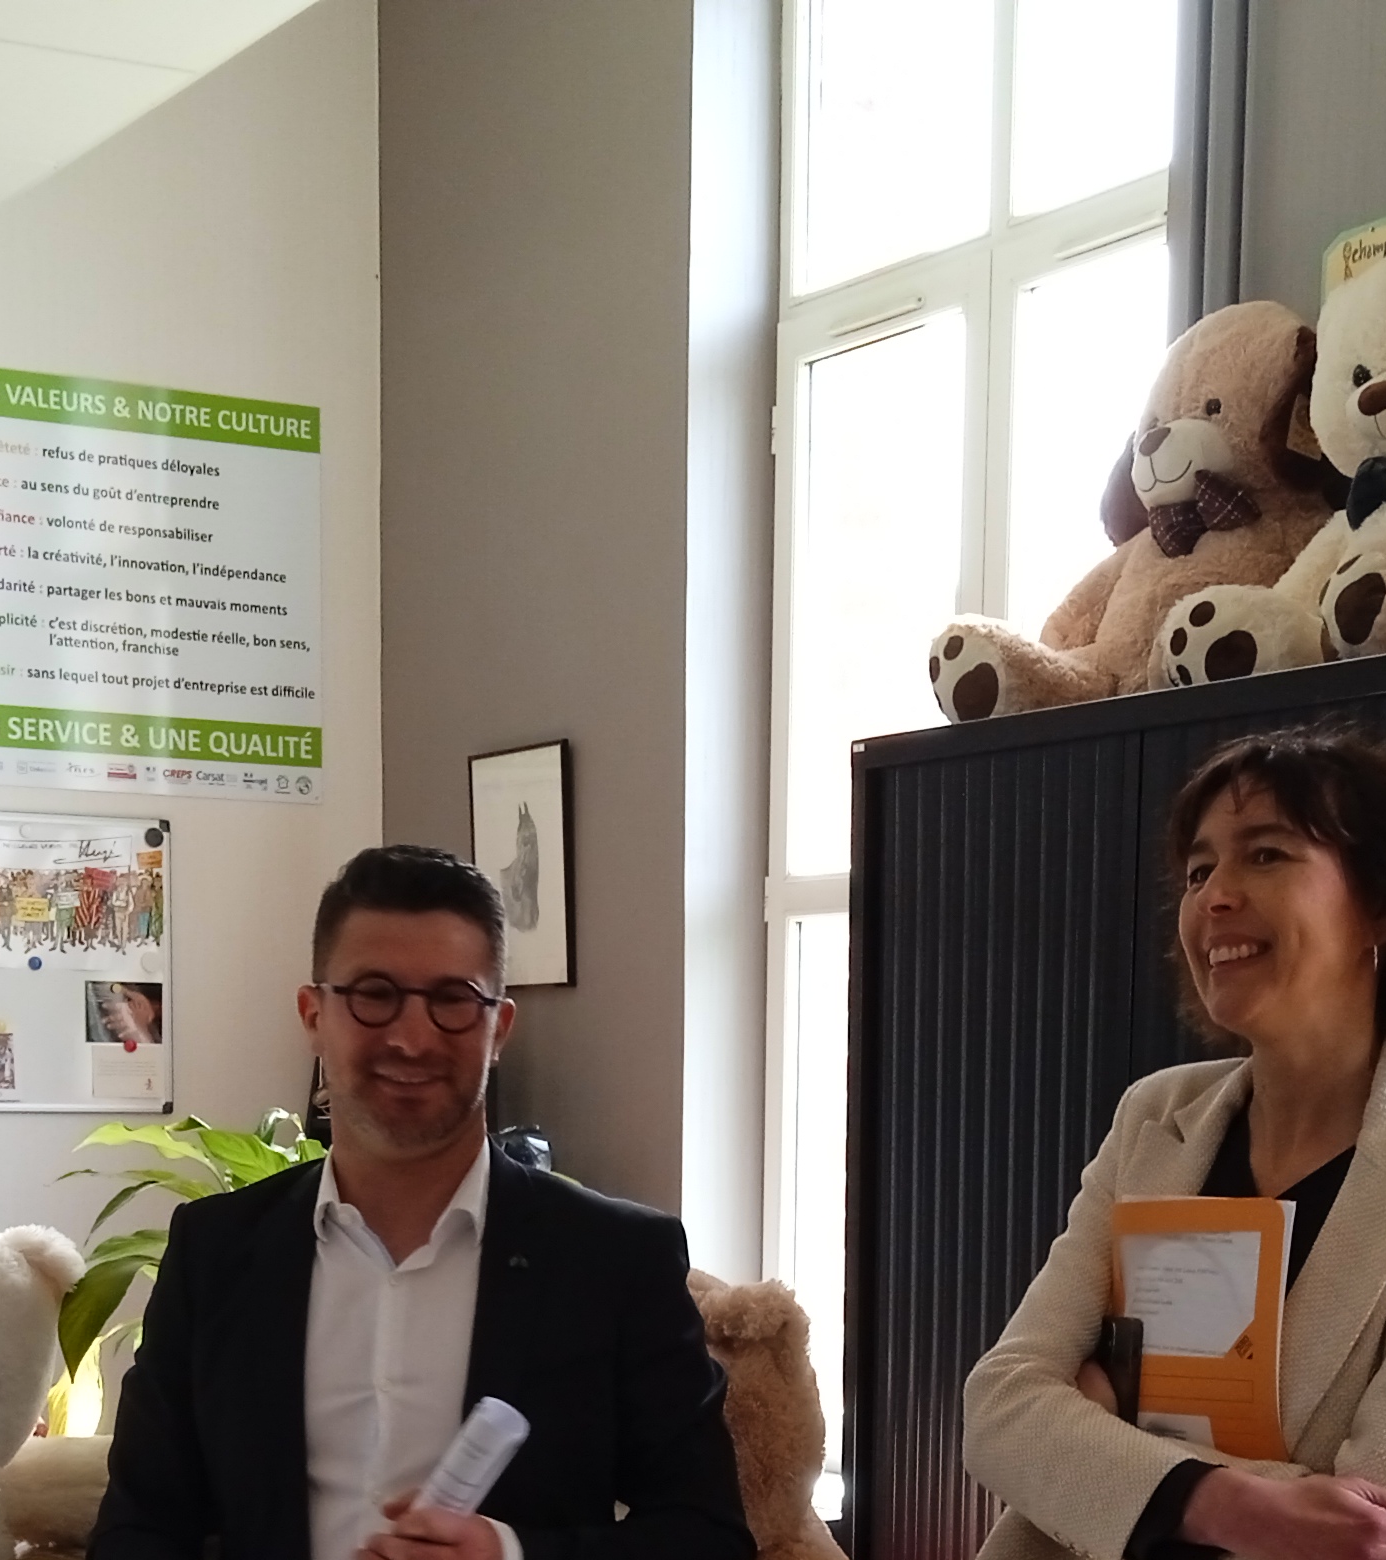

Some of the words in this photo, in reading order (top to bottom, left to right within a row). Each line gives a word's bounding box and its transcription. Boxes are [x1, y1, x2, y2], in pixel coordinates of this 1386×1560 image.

[6, 384, 106, 416] VALEURS
[113, 397, 130, 418] &
[137, 400, 210, 427] NOTRE
[218, 410, 311, 439] CULTURE
[43, 447, 74, 460] refus
[99, 455, 157, 469] pratiques
[162, 460, 219, 476] déloyales
[41, 483, 69, 494] sens
[93, 487, 121, 499] goût
[47, 516, 95, 530] volonté
[119, 526, 213, 542] responsabiliser
[43, 550, 106, 568] créativité,
[47, 586, 101, 600] partager
[105, 588, 122, 601] les
[126, 590, 155, 604] bons
[176, 598, 226, 610] mauvais
[230, 603, 287, 616] moments
[81, 621, 147, 639] discrétion,
[151, 628, 208, 642] modestie
[212, 632, 249, 647] réelle,
[254, 635, 276, 647] bon
[280, 640, 310, 652] sens,
[122, 640, 179, 656] franchise
[28, 669, 55, 679] sans
[59, 668, 98, 683] lequel
[102, 674, 128, 685] tout
[133, 676, 169, 690] projet
[272, 686, 314, 699] difficile
[8, 715, 111, 748] SERVICE
[120, 724, 140, 747] &
[149, 721, 200, 752] UNE
[209, 731, 312, 759] QUALITÉ
[163, 769, 192, 781] CREPS
